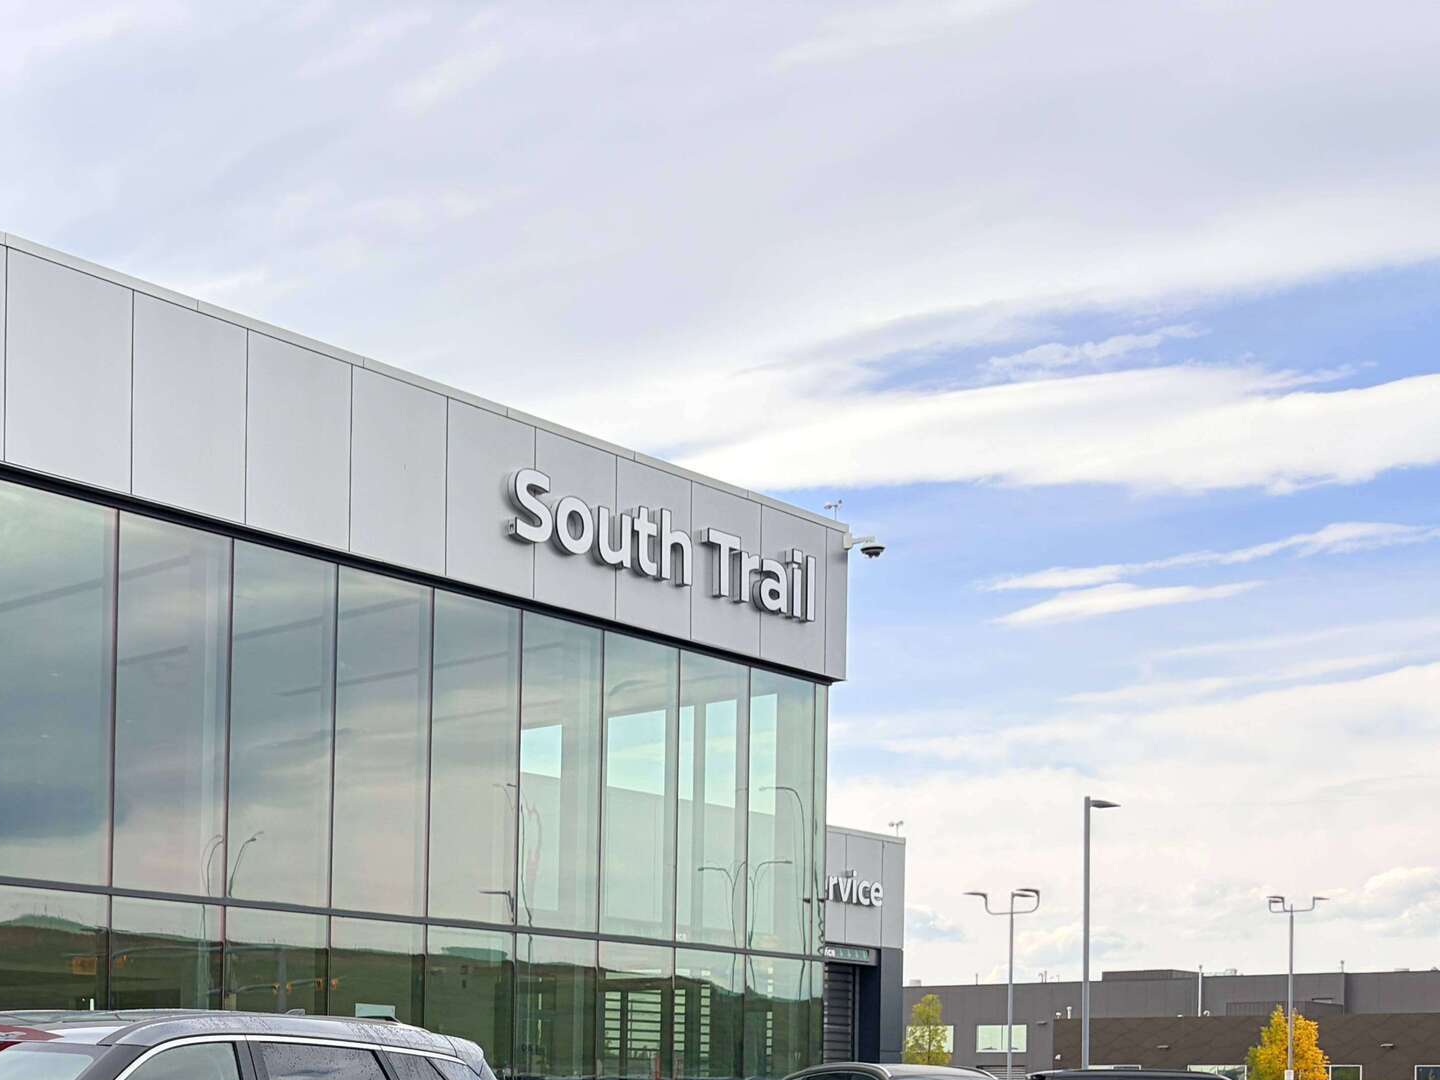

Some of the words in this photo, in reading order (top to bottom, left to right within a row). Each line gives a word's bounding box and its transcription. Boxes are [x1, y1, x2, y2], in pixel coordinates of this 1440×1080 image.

[510, 467, 692, 586] South
[706, 526, 816, 622] Trail
[825, 870, 884, 907] rvice
